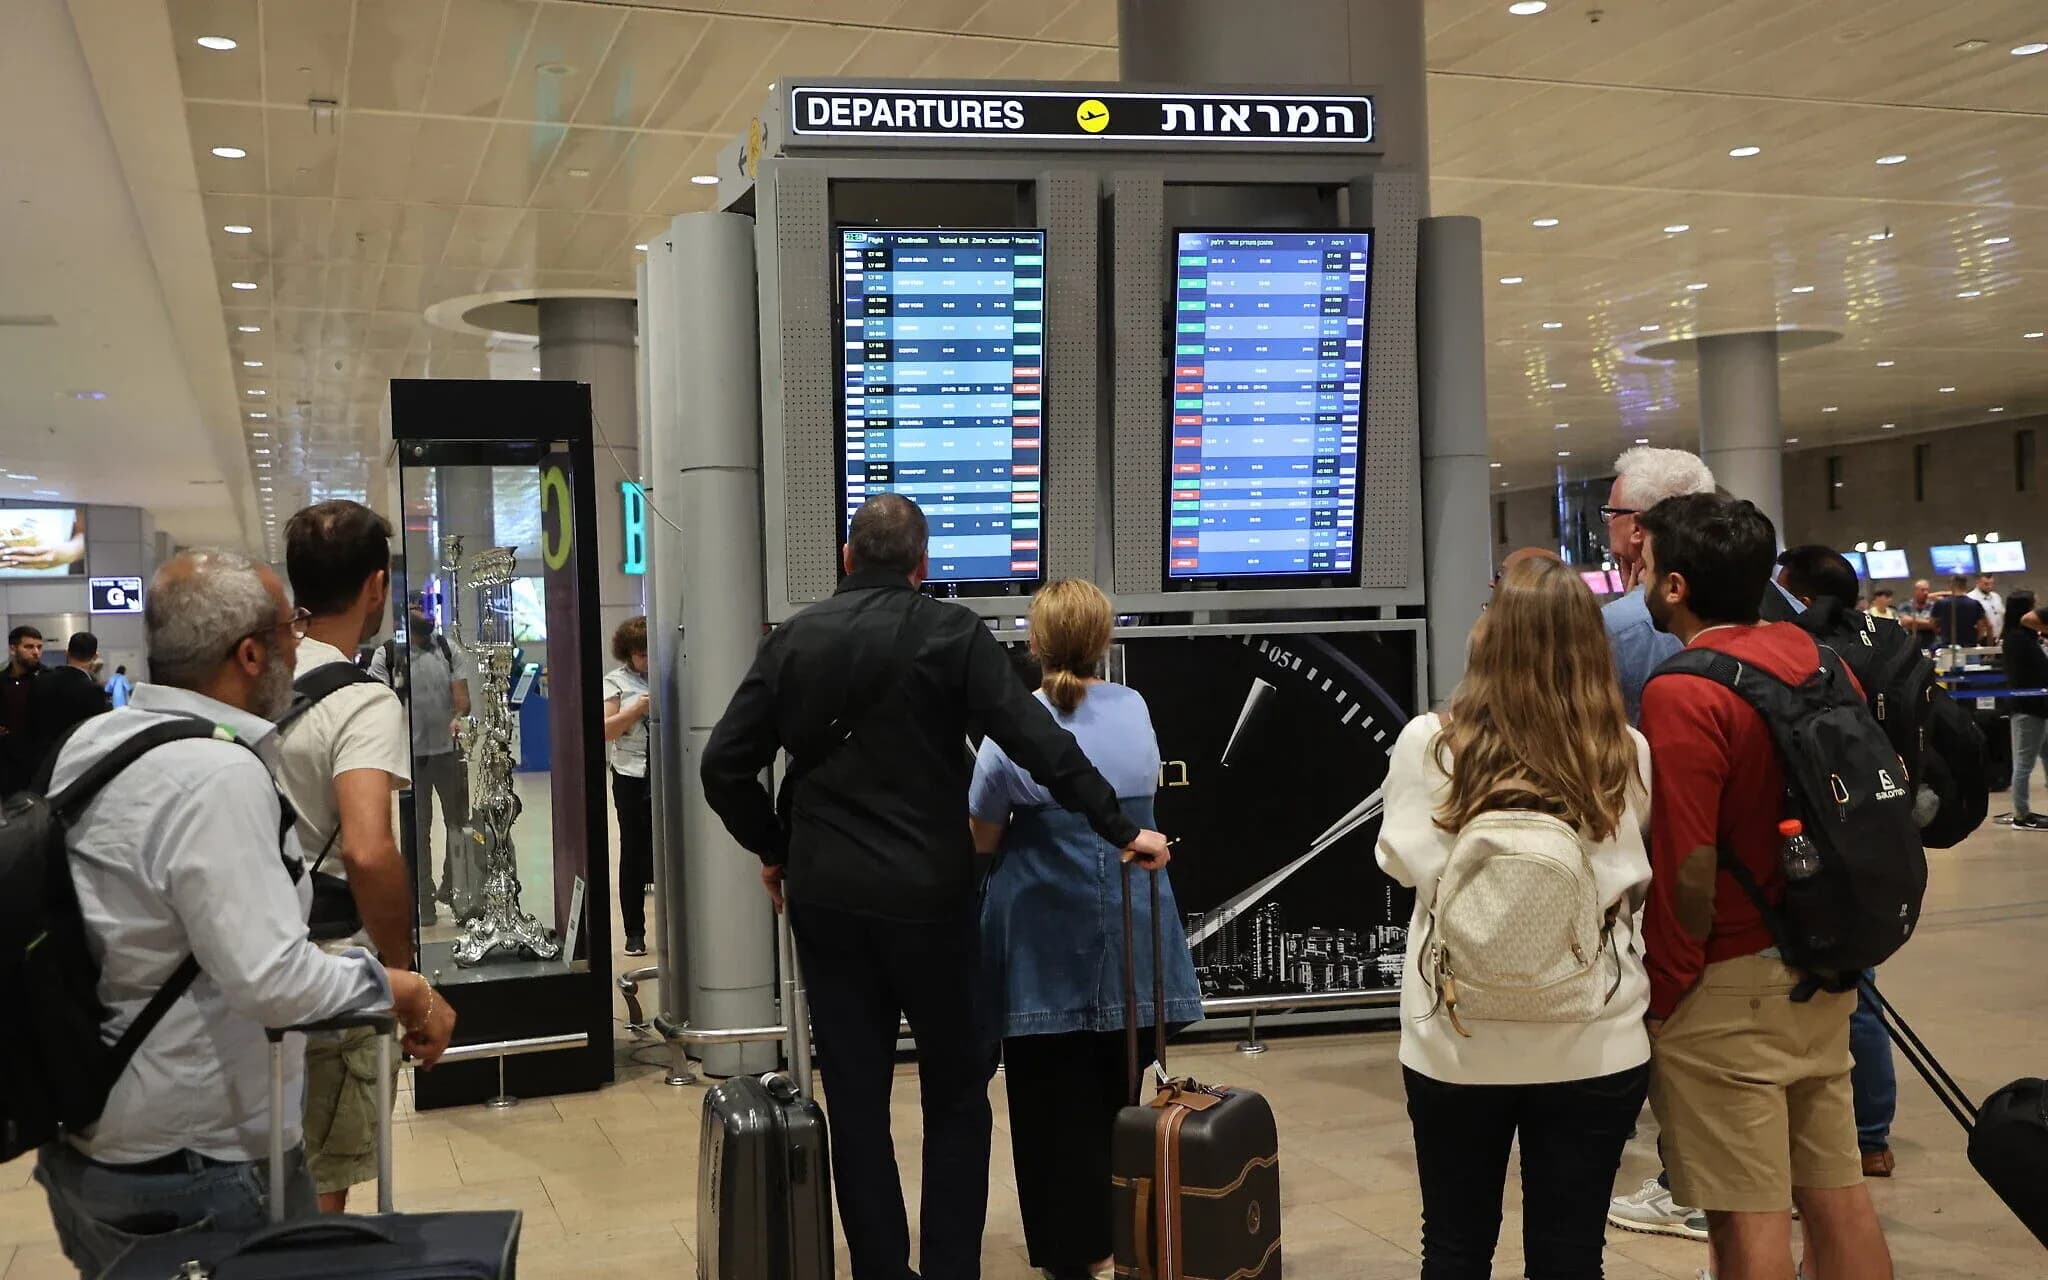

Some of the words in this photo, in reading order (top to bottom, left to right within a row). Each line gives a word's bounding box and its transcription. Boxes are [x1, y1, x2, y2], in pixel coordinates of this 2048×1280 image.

[807, 97, 1025, 129] DEPARTURES
[1161, 102, 1355, 133] המראות
[622, 481, 647, 574] B
[107, 587, 125, 606] G
[1268, 646, 1293, 668] 05
